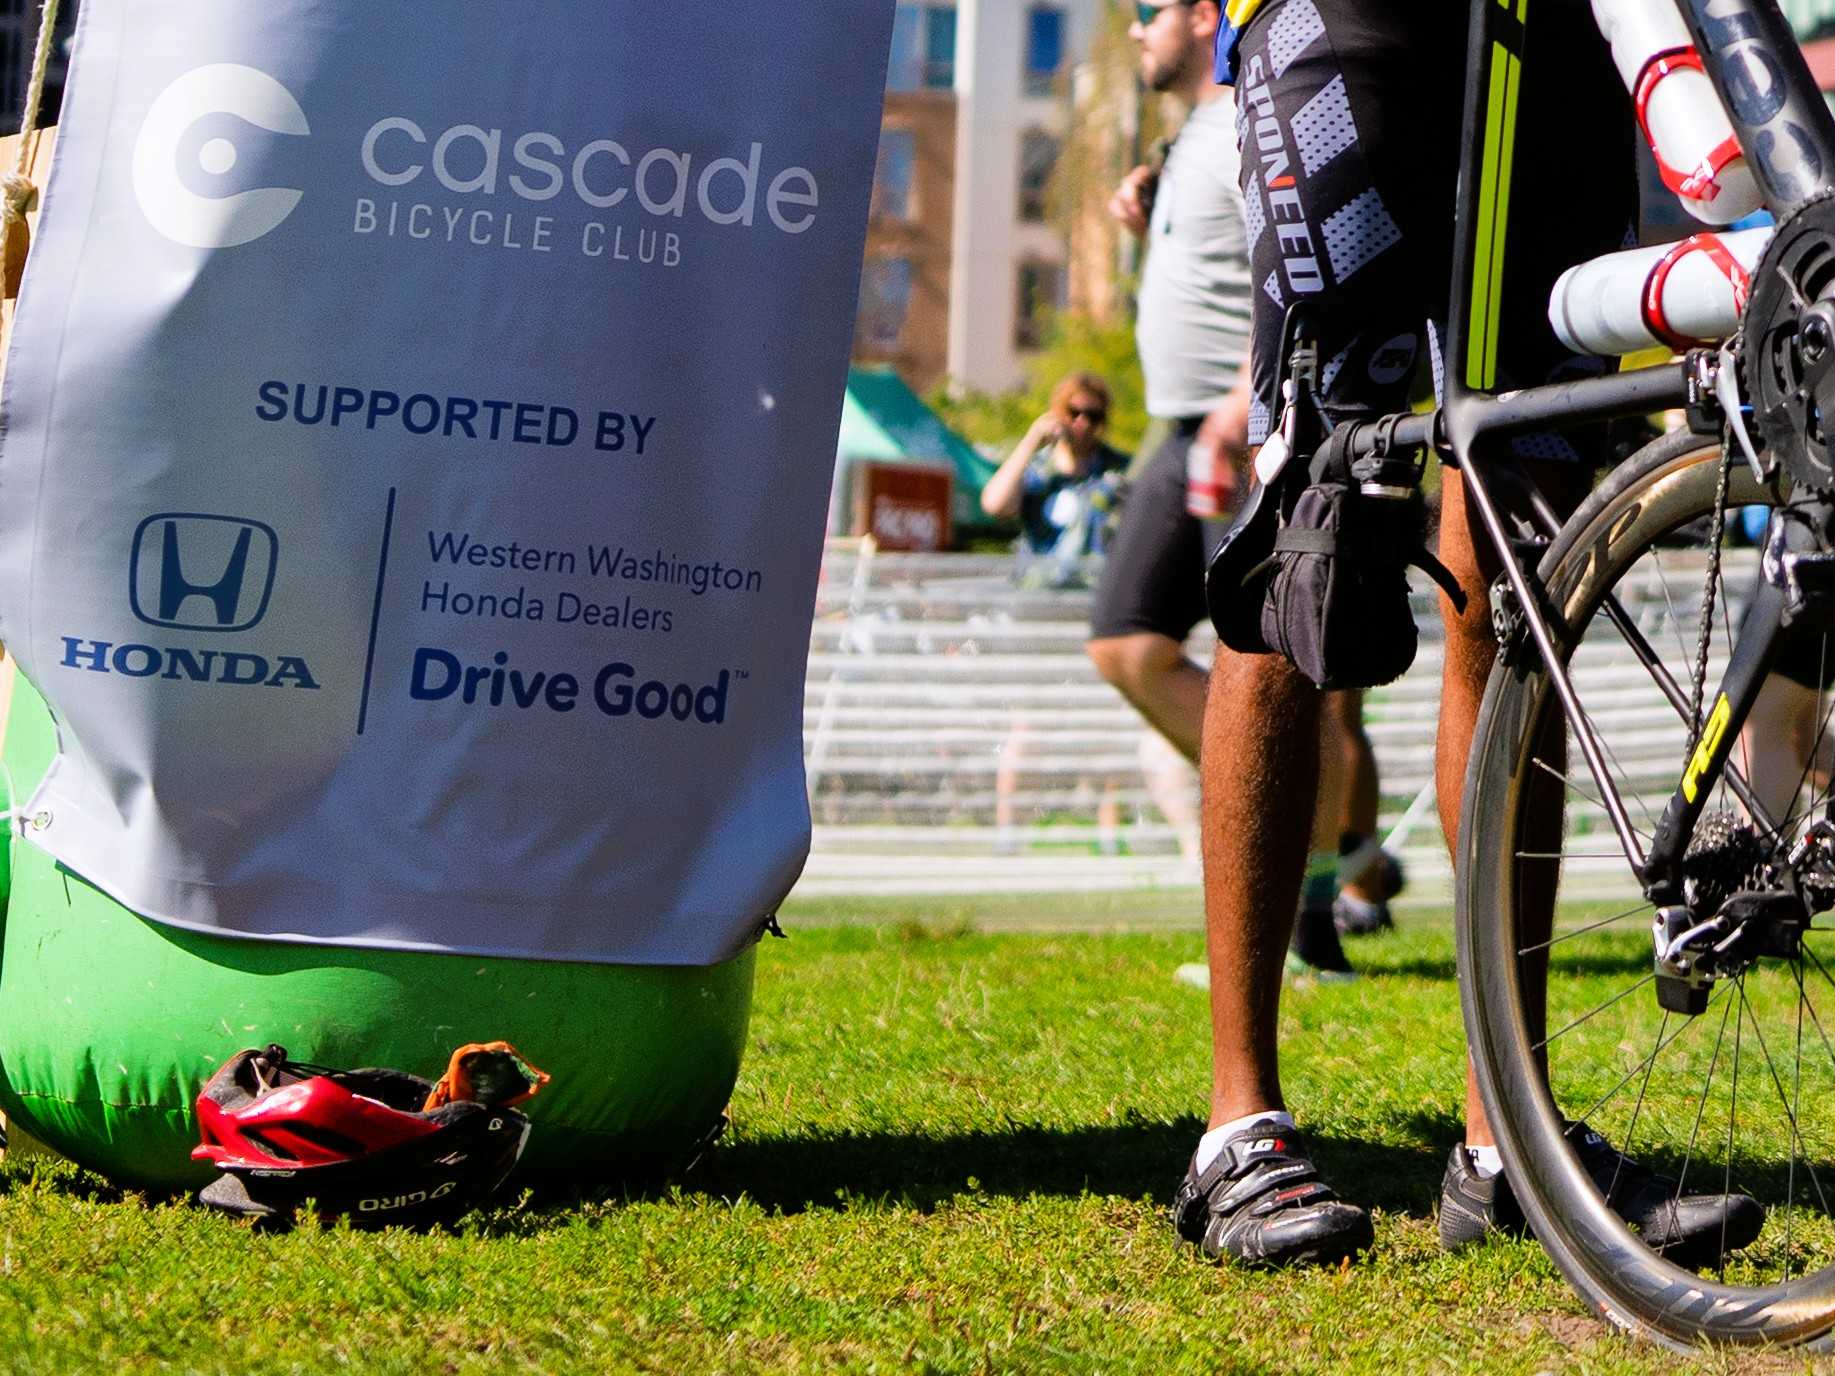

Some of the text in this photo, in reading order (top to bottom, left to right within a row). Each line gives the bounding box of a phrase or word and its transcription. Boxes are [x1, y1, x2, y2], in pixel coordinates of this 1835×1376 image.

[358, 114, 820, 235] cascade
[1244, 53, 1325, 294] SPONEED
[353, 196, 683, 269] BICYCLE CLUB
[254, 378, 658, 456] SUPPORTED BY
[426, 529, 764, 598] Western Washington
[420, 580, 675, 634] Honda Dealers
[57, 634, 322, 692] HONDA
[409, 645, 577, 714] Drive
[358, 1190, 427, 1212] GIRO
